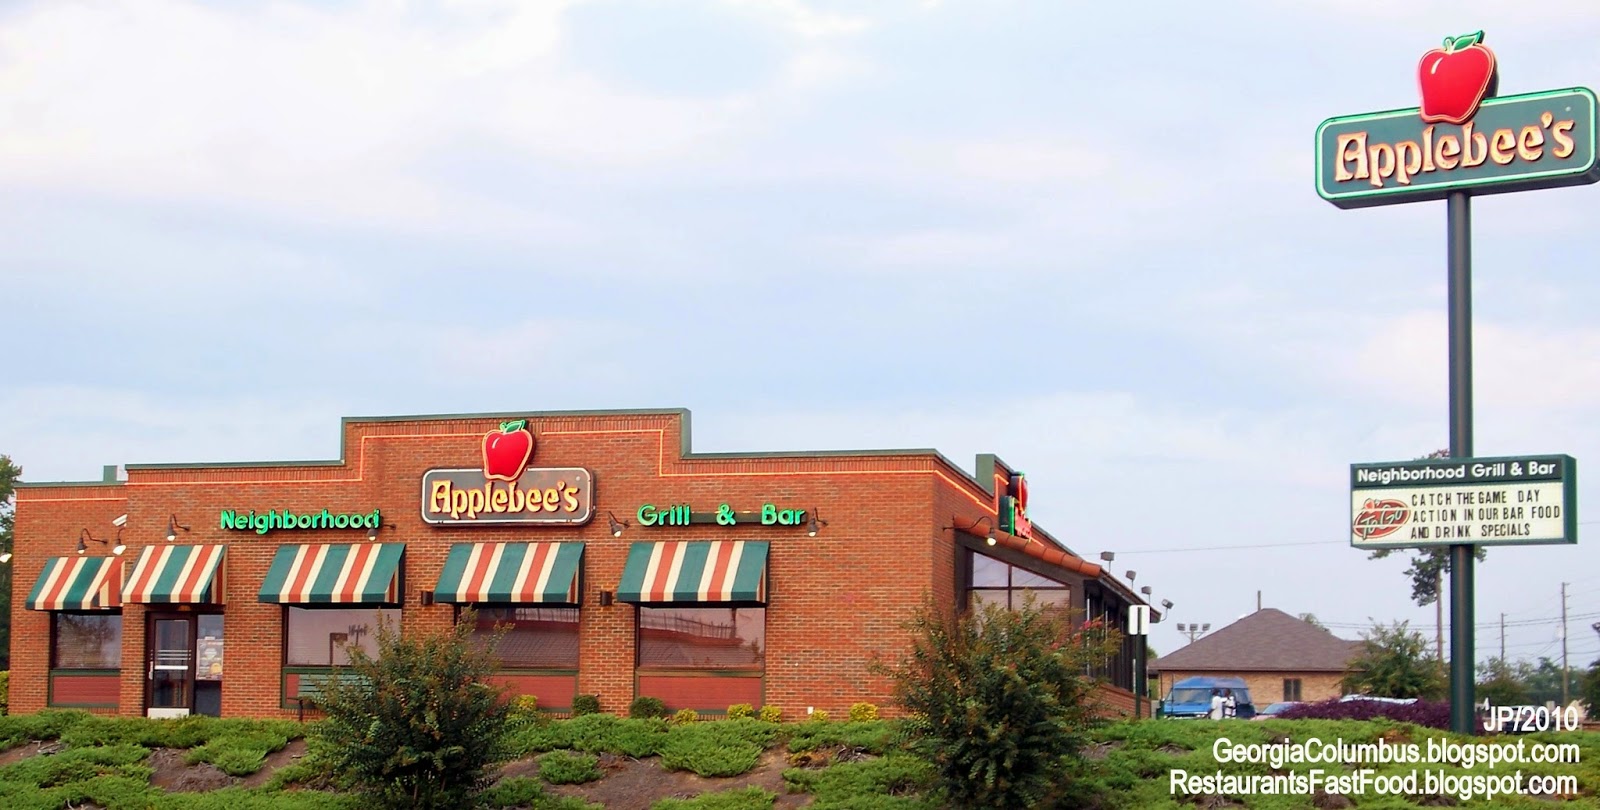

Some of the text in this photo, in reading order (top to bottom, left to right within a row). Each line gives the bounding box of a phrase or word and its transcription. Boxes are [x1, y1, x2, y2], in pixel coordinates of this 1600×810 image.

[1335, 112, 1575, 188] Applebee's
[1357, 461, 1556, 485] Neighborhood Grill & Bar
[429, 479, 580, 519] Applebee's
[1411, 490, 1540, 506] CATCH THE GAME DAY
[220, 508, 381, 535] Neighborhood
[637, 503, 805, 526] Grill & Bar
[1412, 505, 1561, 523] ACTION IN OUR BAR FOOD
[1411, 523, 1531, 539] AND DRINK SPECIALS
